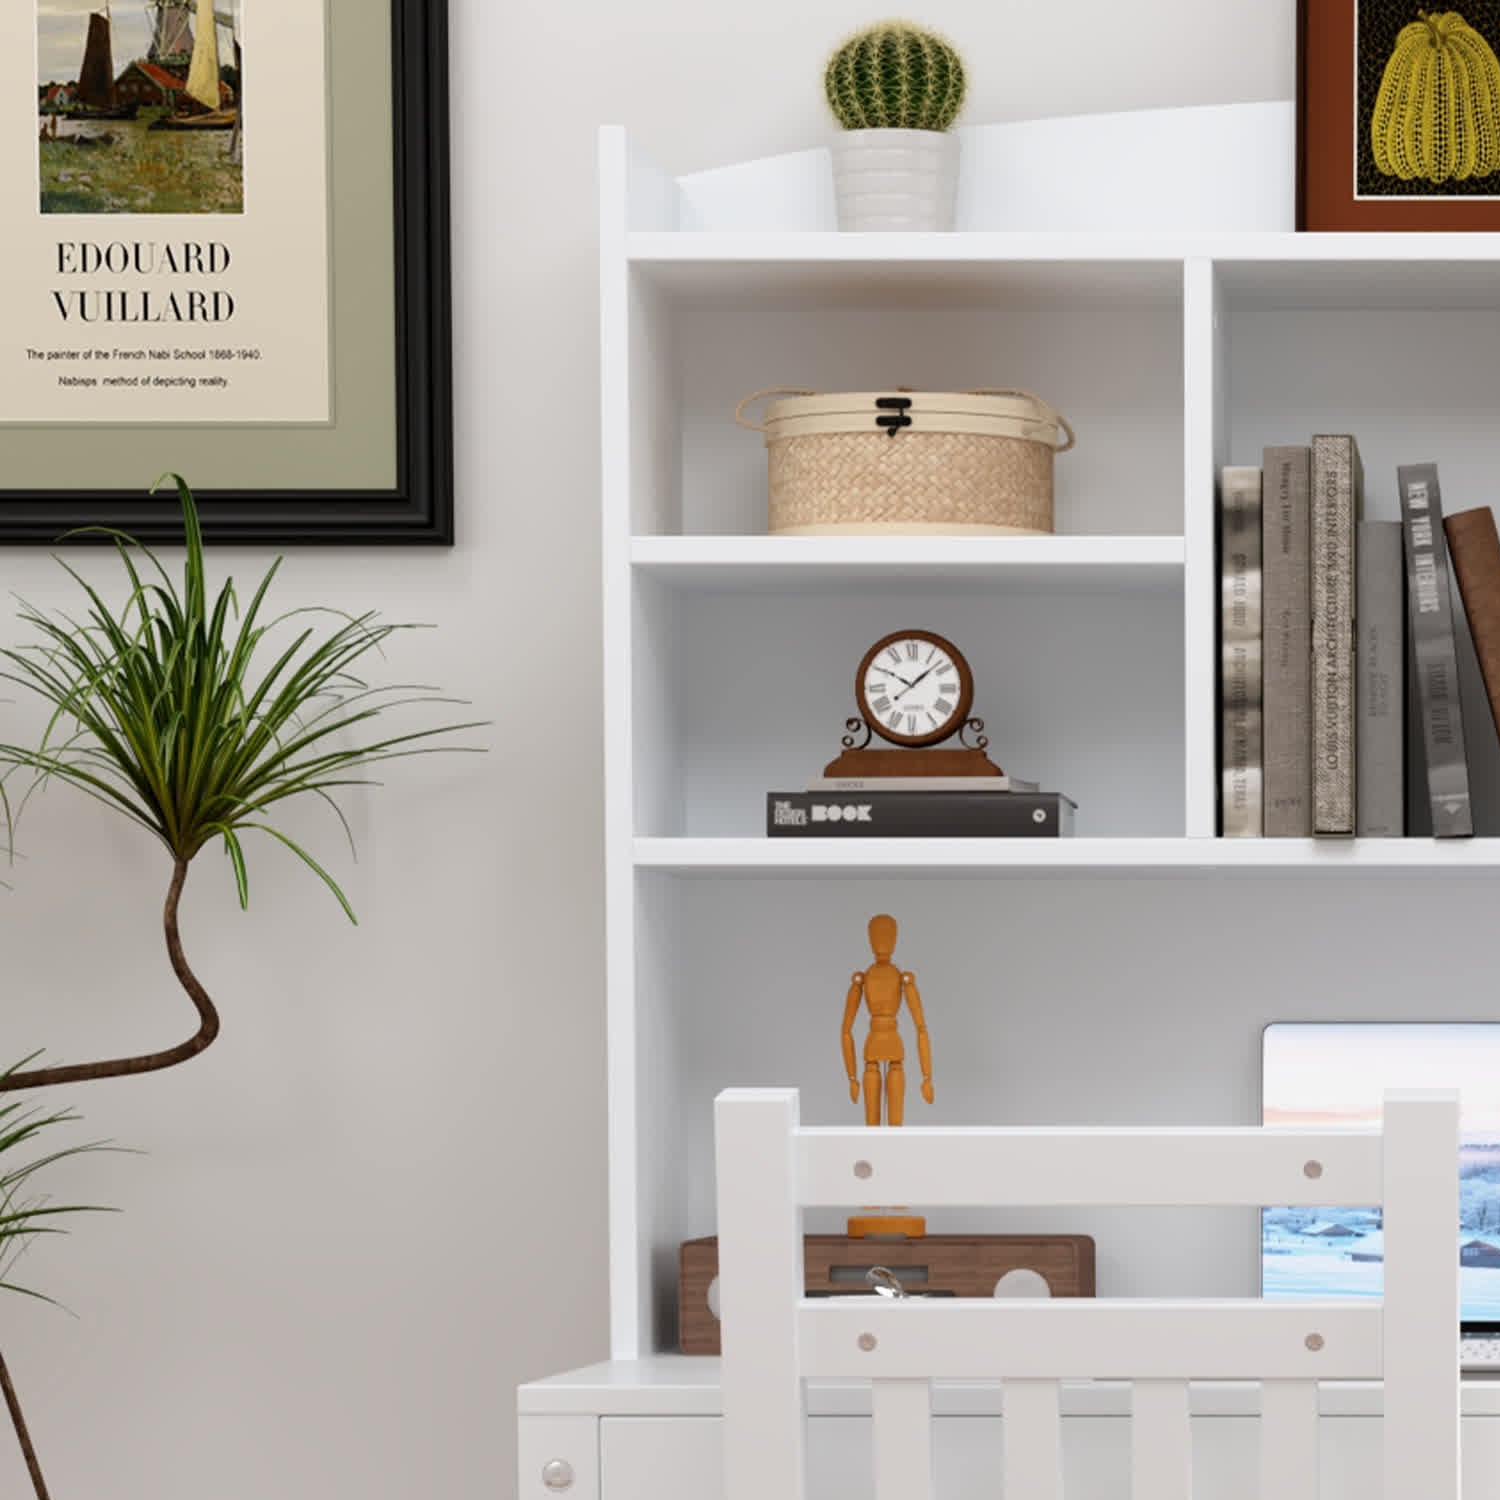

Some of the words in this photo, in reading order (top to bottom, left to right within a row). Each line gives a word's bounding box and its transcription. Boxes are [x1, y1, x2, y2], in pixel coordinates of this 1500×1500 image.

[56, 242, 231, 273] EDOUARD
[51, 290, 235, 321] VUILLARD
[26, 349, 45, 361] The
[47, 349, 80, 363] painter
[83, 349, 92, 360] of
[94, 349, 110, 361] the
[113, 349, 146, 361] French
[149, 349, 171, 361] Nabi
[173, 349, 206, 361] School
[103, 376, 139, 387] method
[141, 376, 150, 387] of
[152, 376, 196, 389] depicting
[1326, 732, 1338, 770] LOUIS
[811, 804, 872, 822] BOOK
